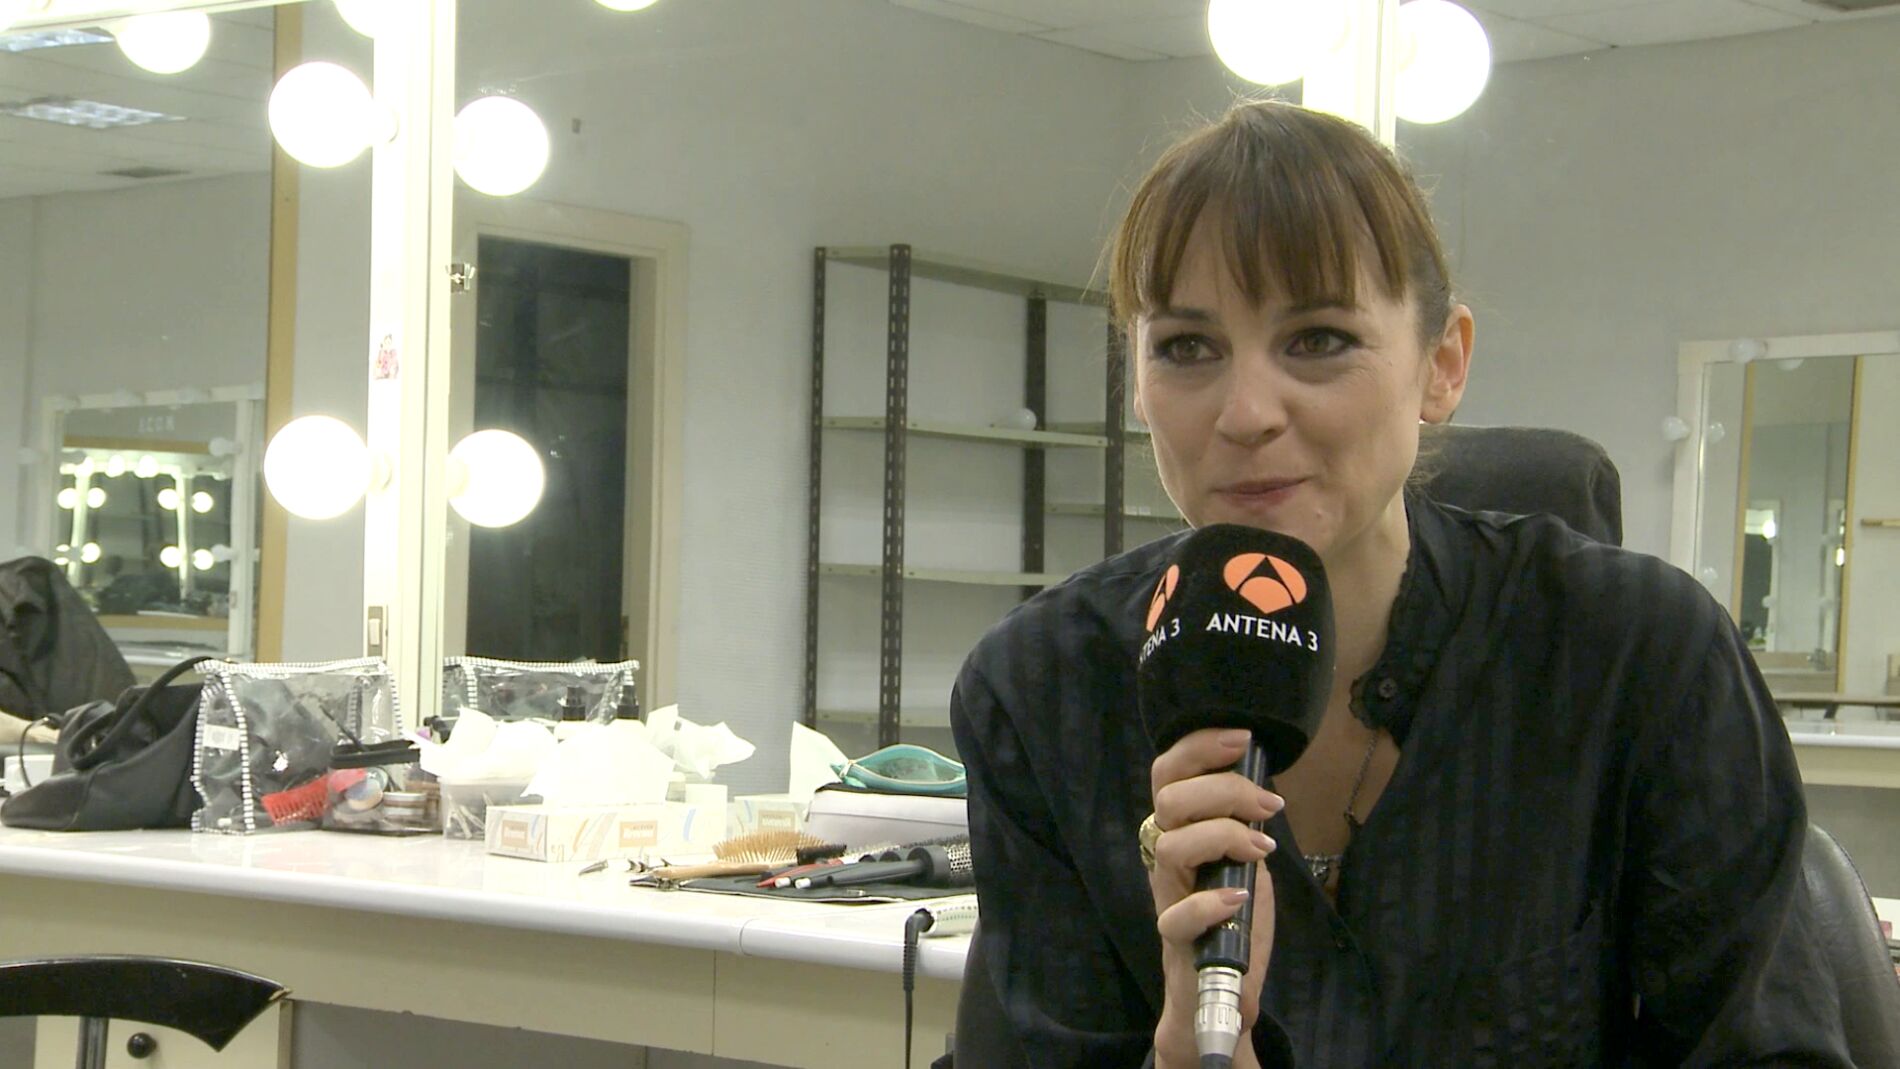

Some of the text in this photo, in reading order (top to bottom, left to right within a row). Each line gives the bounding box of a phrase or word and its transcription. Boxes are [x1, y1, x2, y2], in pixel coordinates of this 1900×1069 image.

[1170, 617, 1181, 638] 3
[1205, 612, 1319, 651] ANTENA 3
